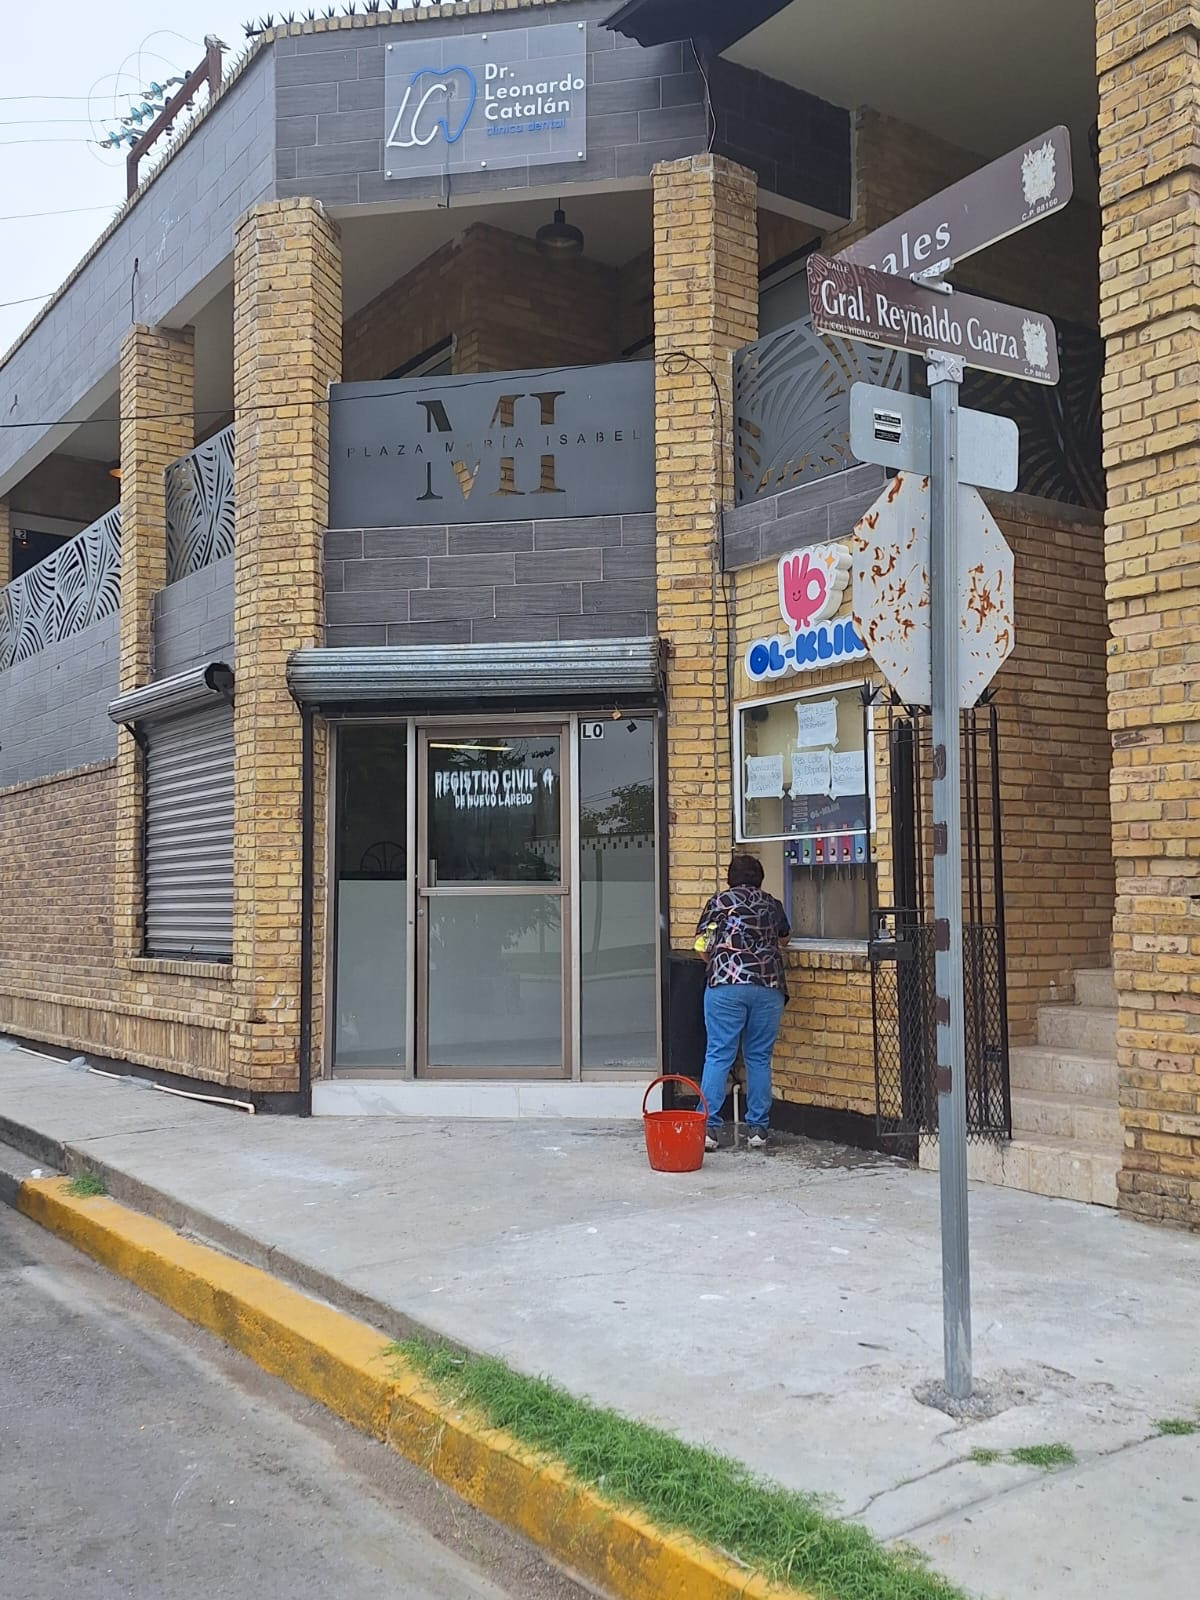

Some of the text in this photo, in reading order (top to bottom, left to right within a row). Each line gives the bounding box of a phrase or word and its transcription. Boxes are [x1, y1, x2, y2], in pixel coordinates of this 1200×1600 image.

[485, 63, 515, 80] Dr.
[484, 73, 585, 100] Leonardo
[484, 97, 570, 120] Catalán
[527, 119, 566, 131] dental
[868, 222, 951, 275] ales
[826, 261, 849, 274] CALLE
[821, 280, 1019, 359] Gral. Reynaldo Garza
[848, 326, 880, 340] HIDALGO
[347, 443, 424, 458] PLAZA
[546, 429, 641, 446] ISABEL
[434, 770, 500, 799] REGISTRO
[502, 768, 538, 792] CIVIL
[455, 793, 533, 809] DE NUEVO LAREDO
